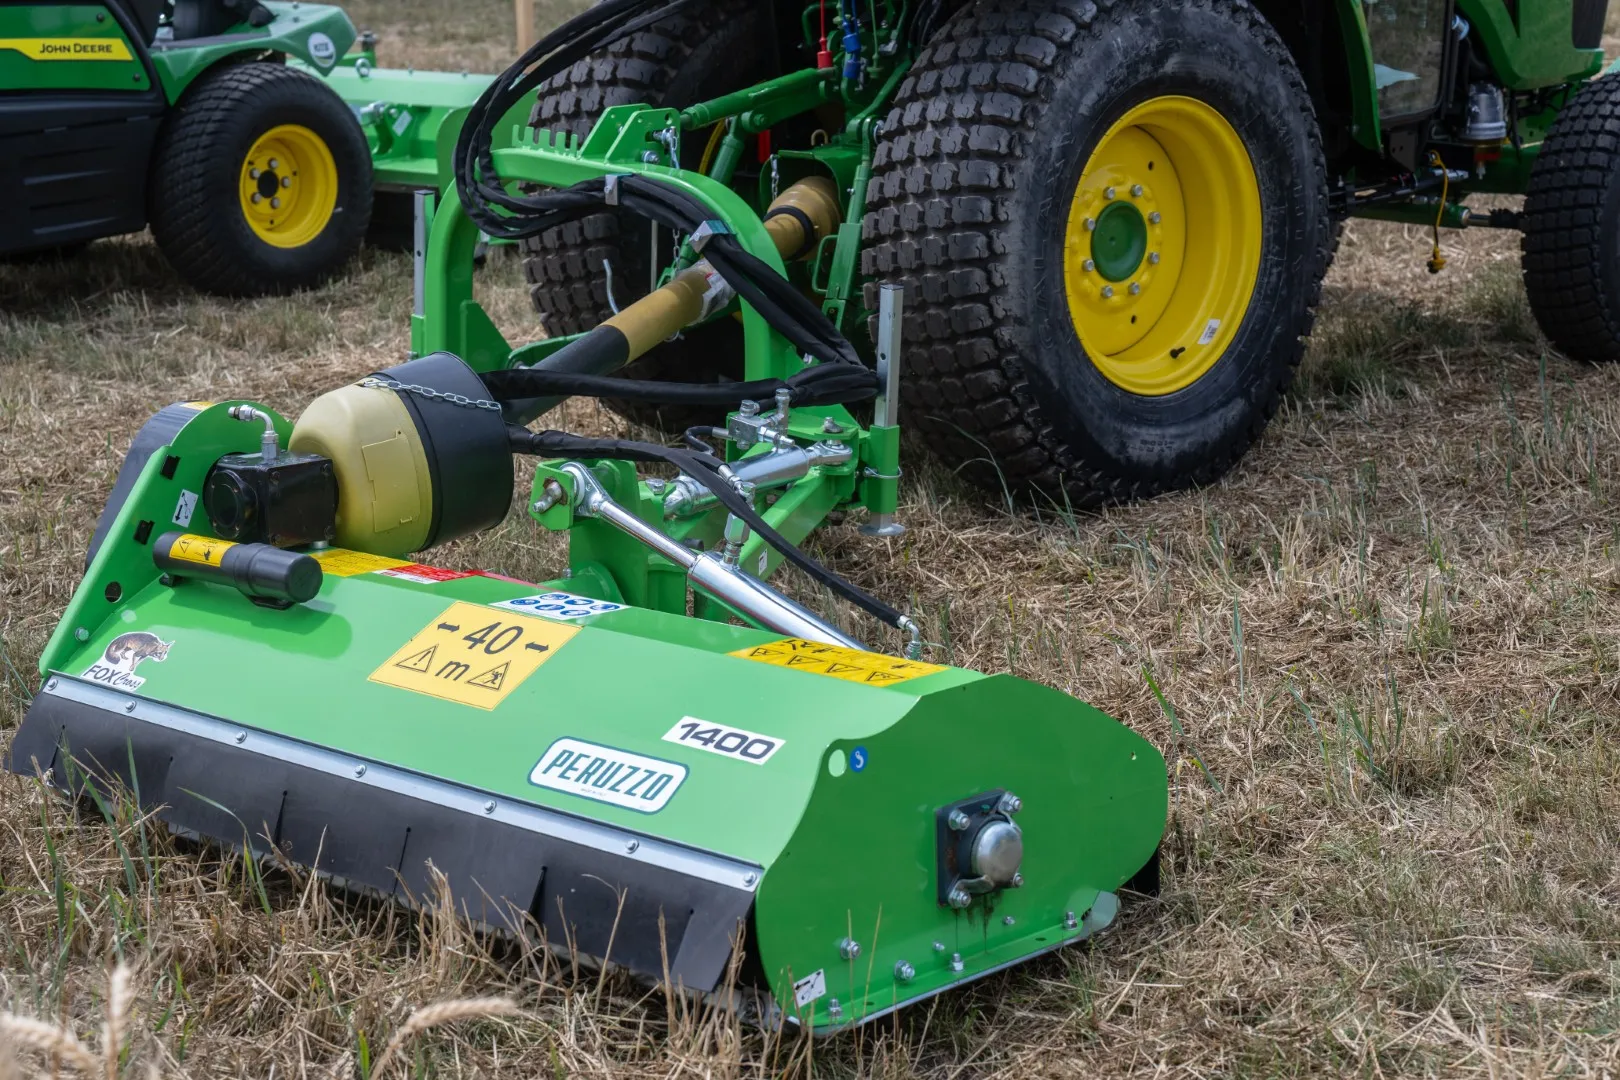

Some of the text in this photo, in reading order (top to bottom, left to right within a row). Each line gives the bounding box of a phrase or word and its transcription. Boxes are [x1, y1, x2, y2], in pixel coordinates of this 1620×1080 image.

[40, 43, 113, 53] JOHN DEERE
[462, 621, 524, 655] 40
[83, 664, 121, 684] FOX
[434, 660, 470, 681] m
[680, 722, 775, 760] 1400
[542, 749, 674, 801] PERUZZO
